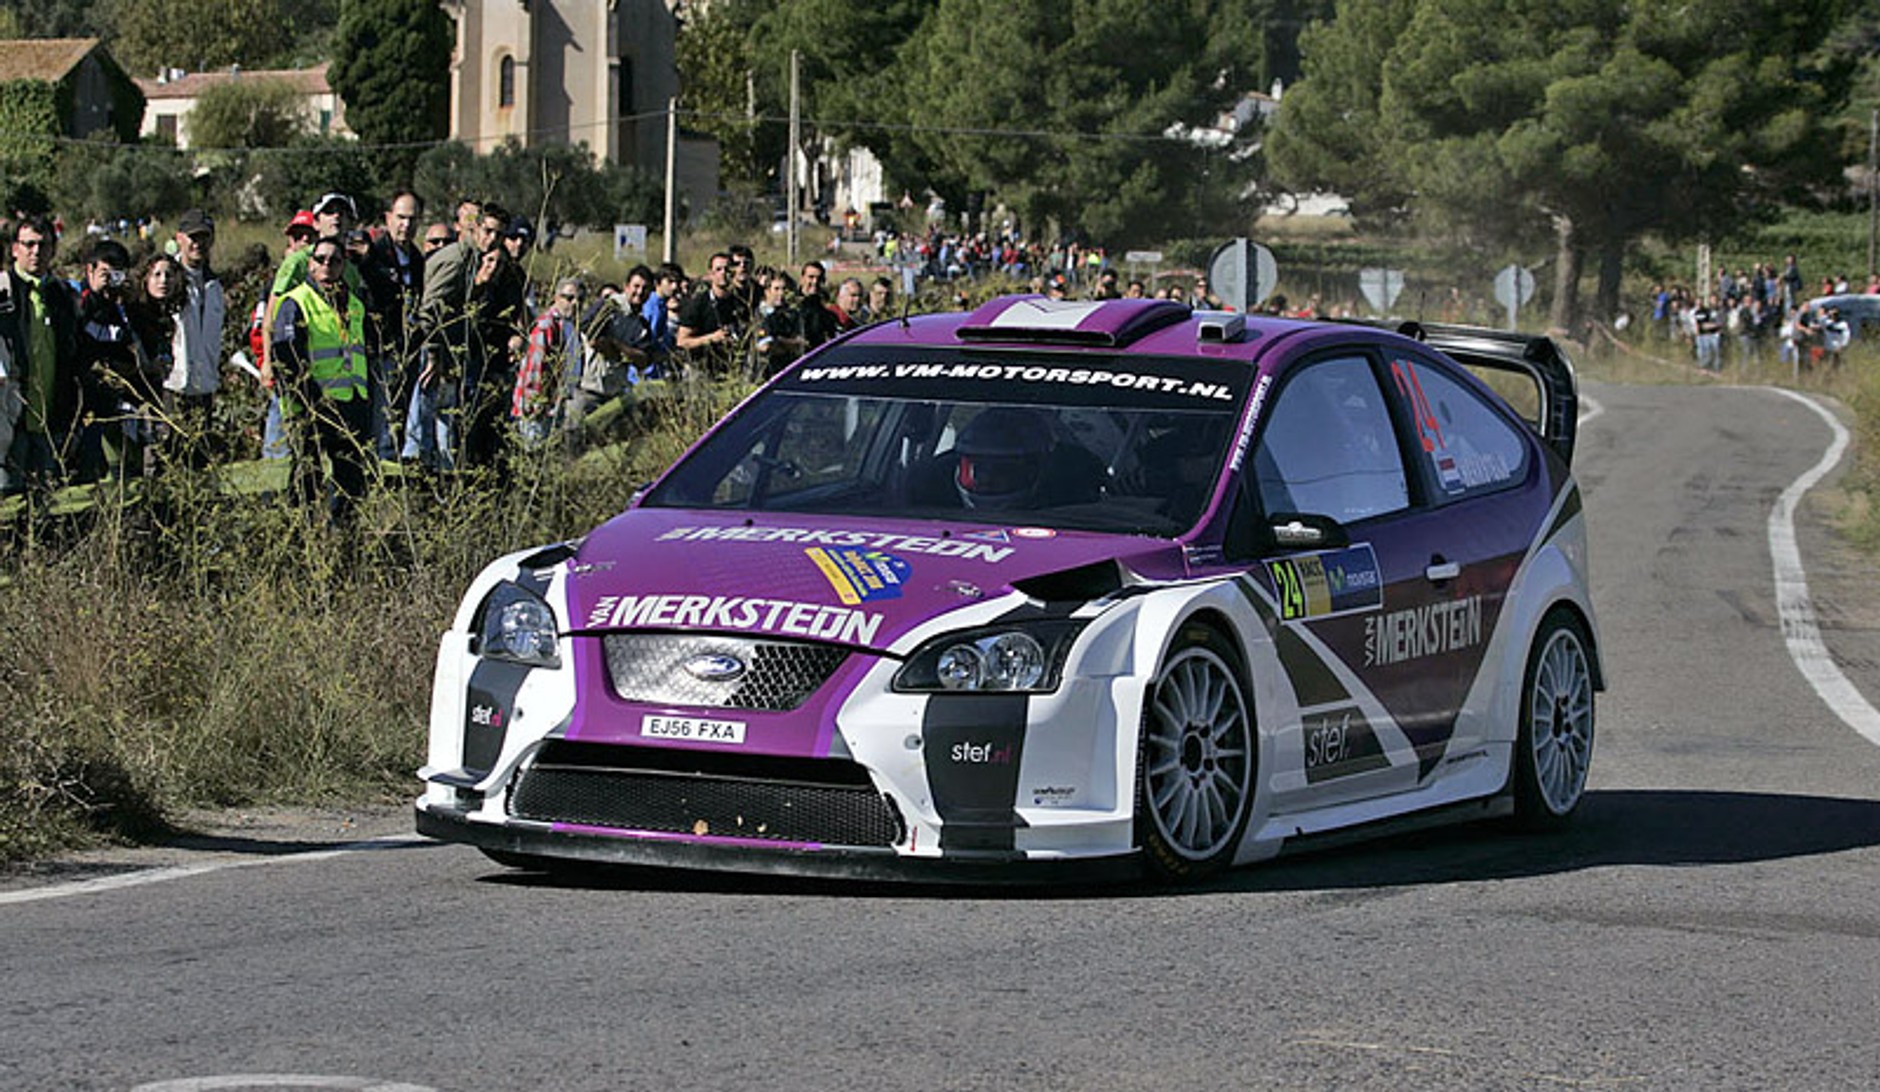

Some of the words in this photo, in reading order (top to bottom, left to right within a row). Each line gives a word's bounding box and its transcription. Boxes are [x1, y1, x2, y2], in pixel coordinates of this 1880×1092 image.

[800, 364, 1233, 400] WWW.VM-MOTORSPORT.NL
[1391, 360, 1447, 453] 24
[1273, 562, 1303, 619] 24
[1364, 615, 1376, 667] VAN
[649, 718, 692, 737] EJ56
[698, 722, 735, 739] FXA
